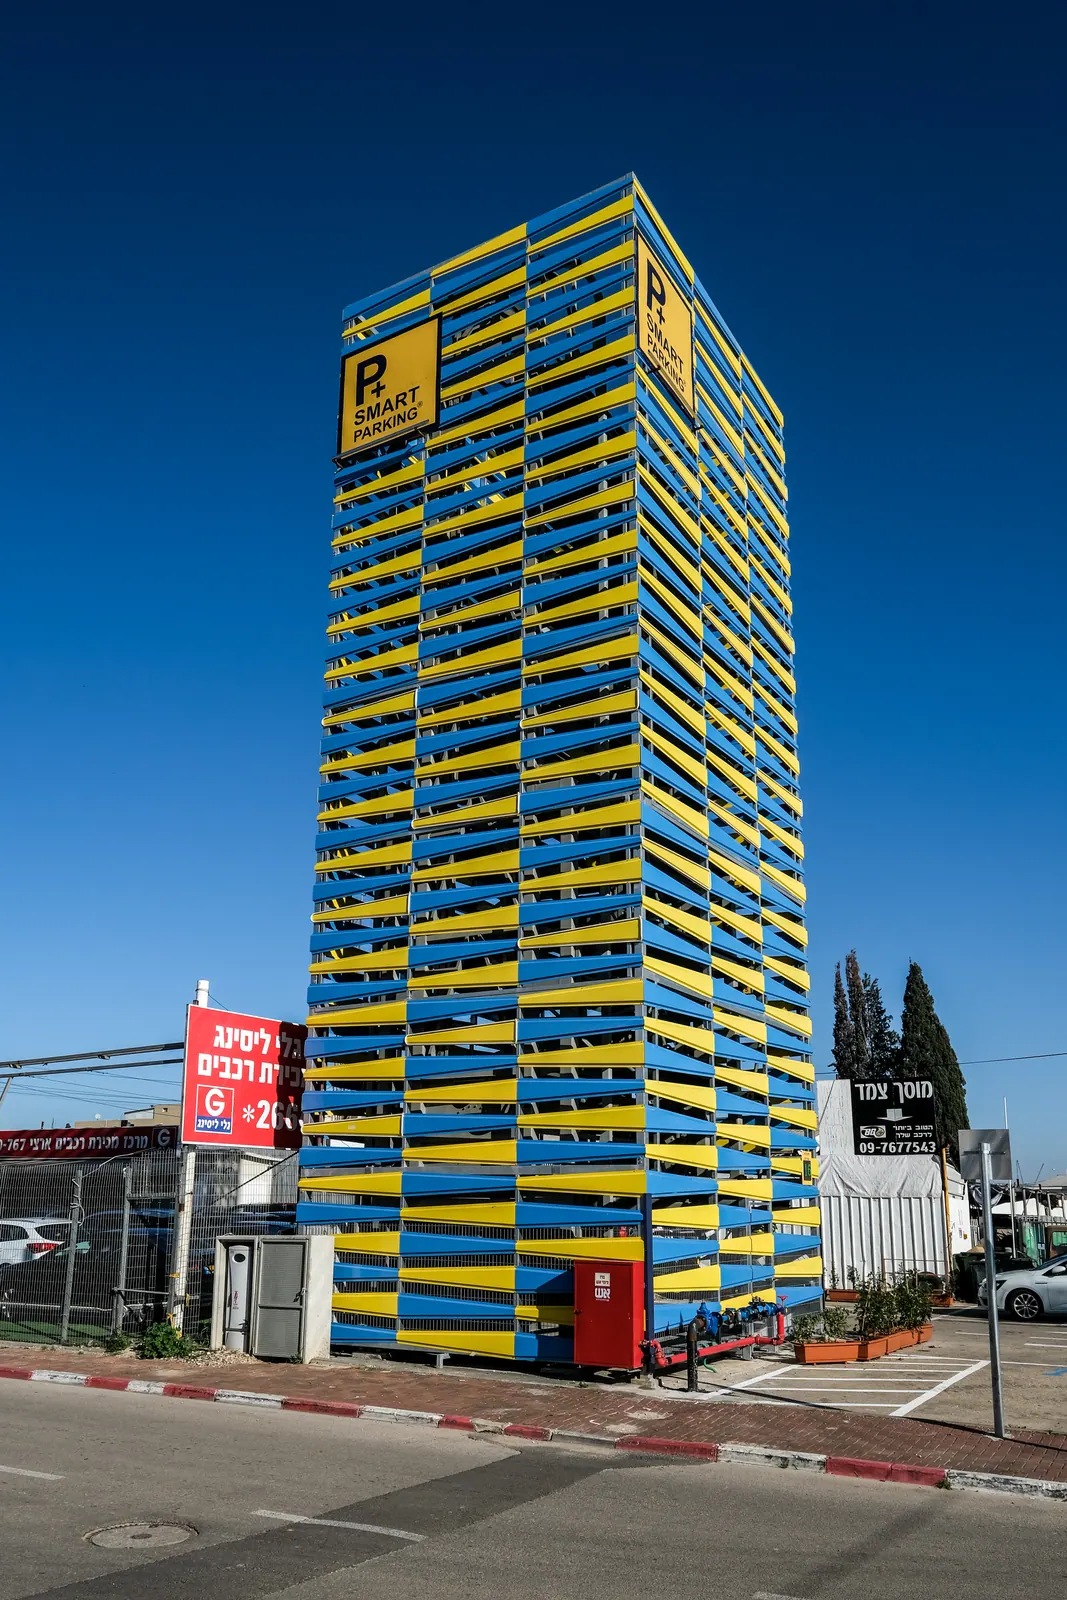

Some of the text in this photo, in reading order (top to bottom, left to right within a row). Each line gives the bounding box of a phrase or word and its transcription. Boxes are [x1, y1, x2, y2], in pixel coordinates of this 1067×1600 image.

[646, 312, 684, 374] SMART
[354, 386, 420, 426] SMART
[213, 1024, 302, 1060] גלי ליסינג
[197, 1053, 255, 1082] רכבים
[854, 1080, 933, 1104] מוסך צמד
[205, 1088, 225, 1117] G
[197, 1118, 219, 1129] ליסינג
[29, 1137, 52, 1151] ארצי
[55, 1137, 86, 1150] רכבים
[87, 1135, 119, 1149] מכירת
[123, 1135, 149, 1149] מרכז
[157, 1128, 171, 1147] G
[859, 1141, 936, 1153] 09-7677543
[594, 1288, 610, 1299] אש
